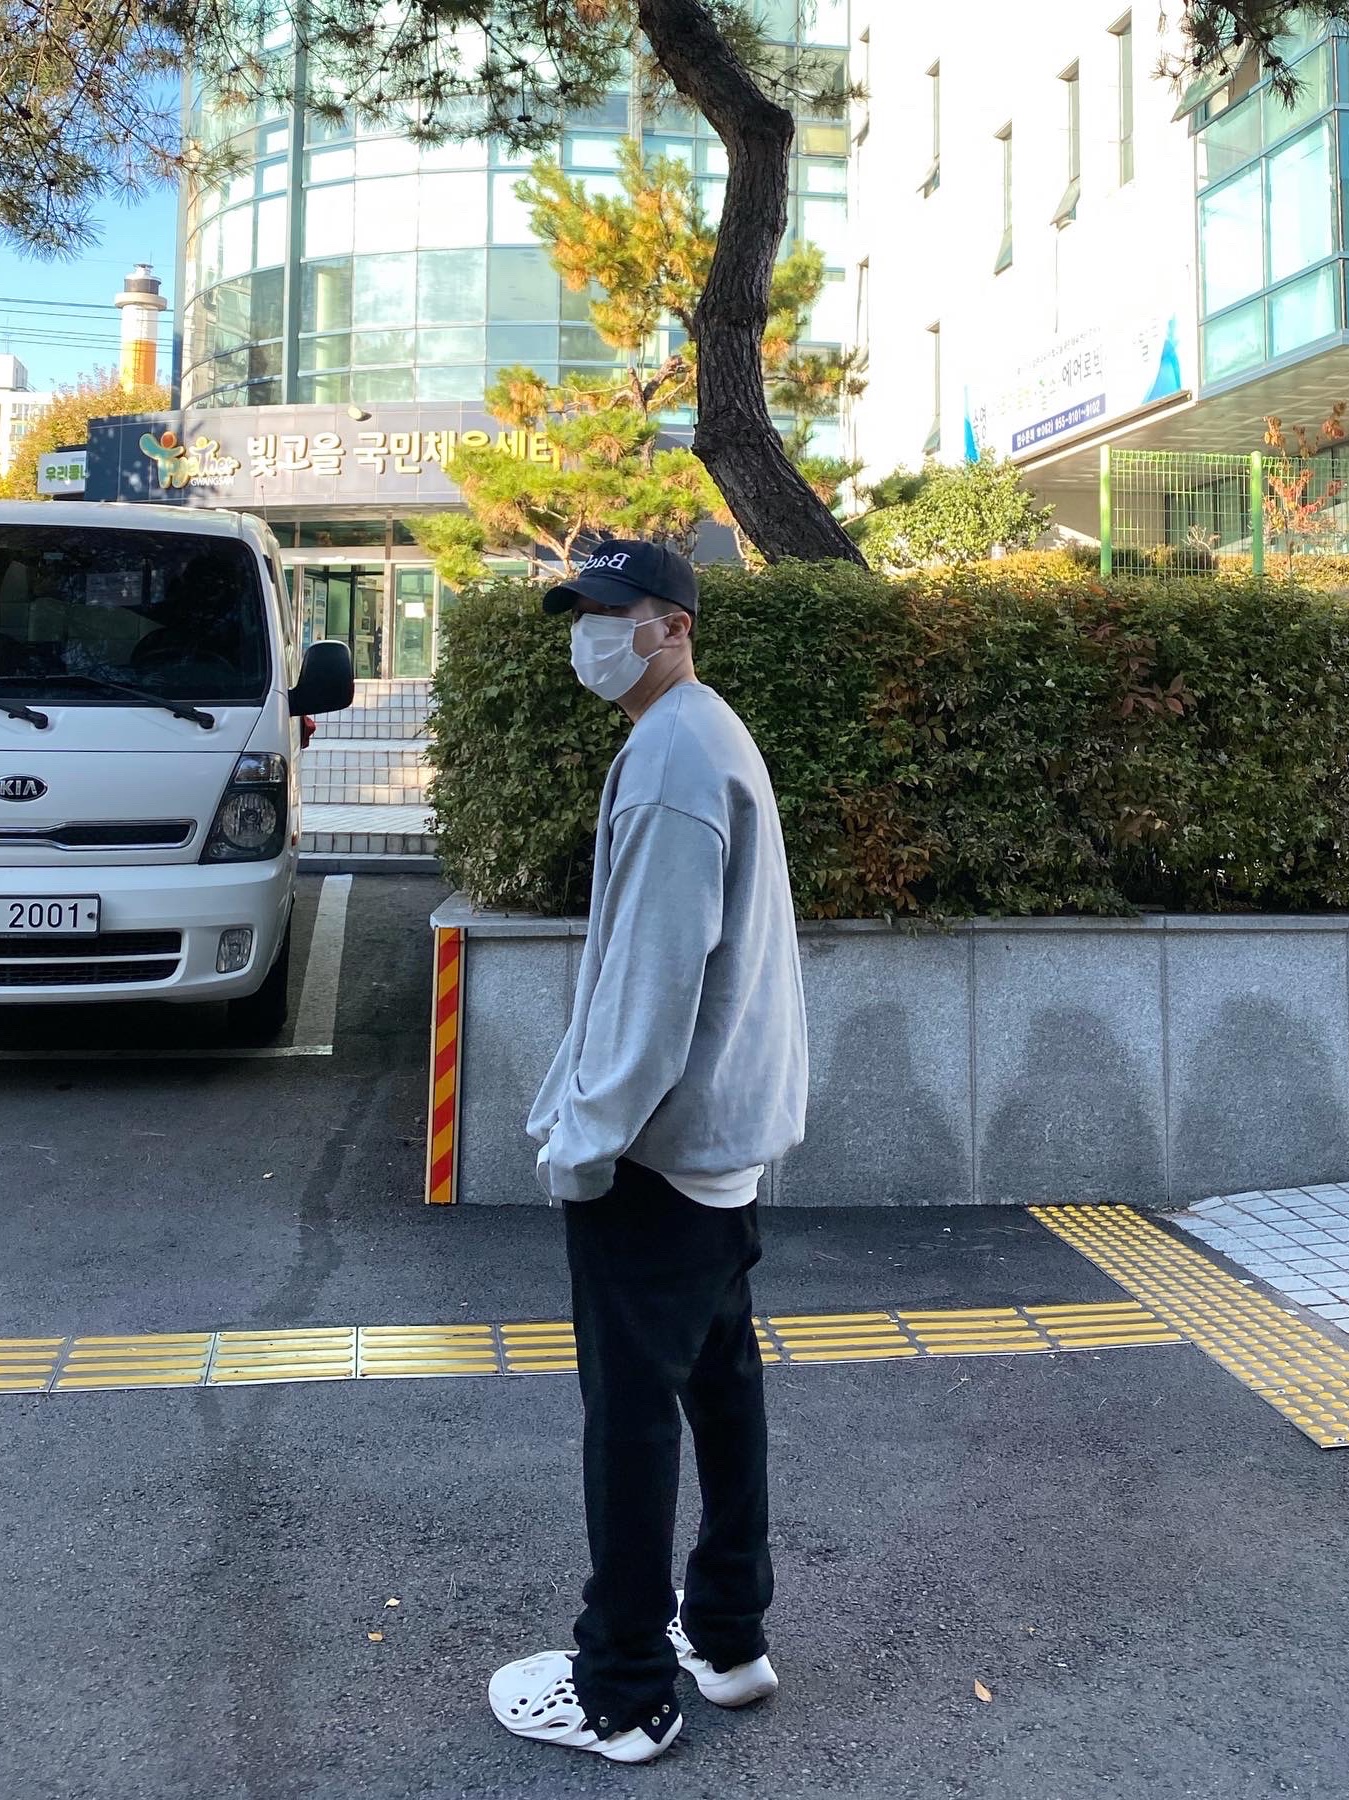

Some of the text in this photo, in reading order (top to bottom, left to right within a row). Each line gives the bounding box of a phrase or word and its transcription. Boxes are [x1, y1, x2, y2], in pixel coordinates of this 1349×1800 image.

[1061, 347, 1104, 387] 에어로빅
[247, 431, 346, 477] 빛고을
[0, 780, 38, 796] KIA
[9, 903, 78, 929] 2001
